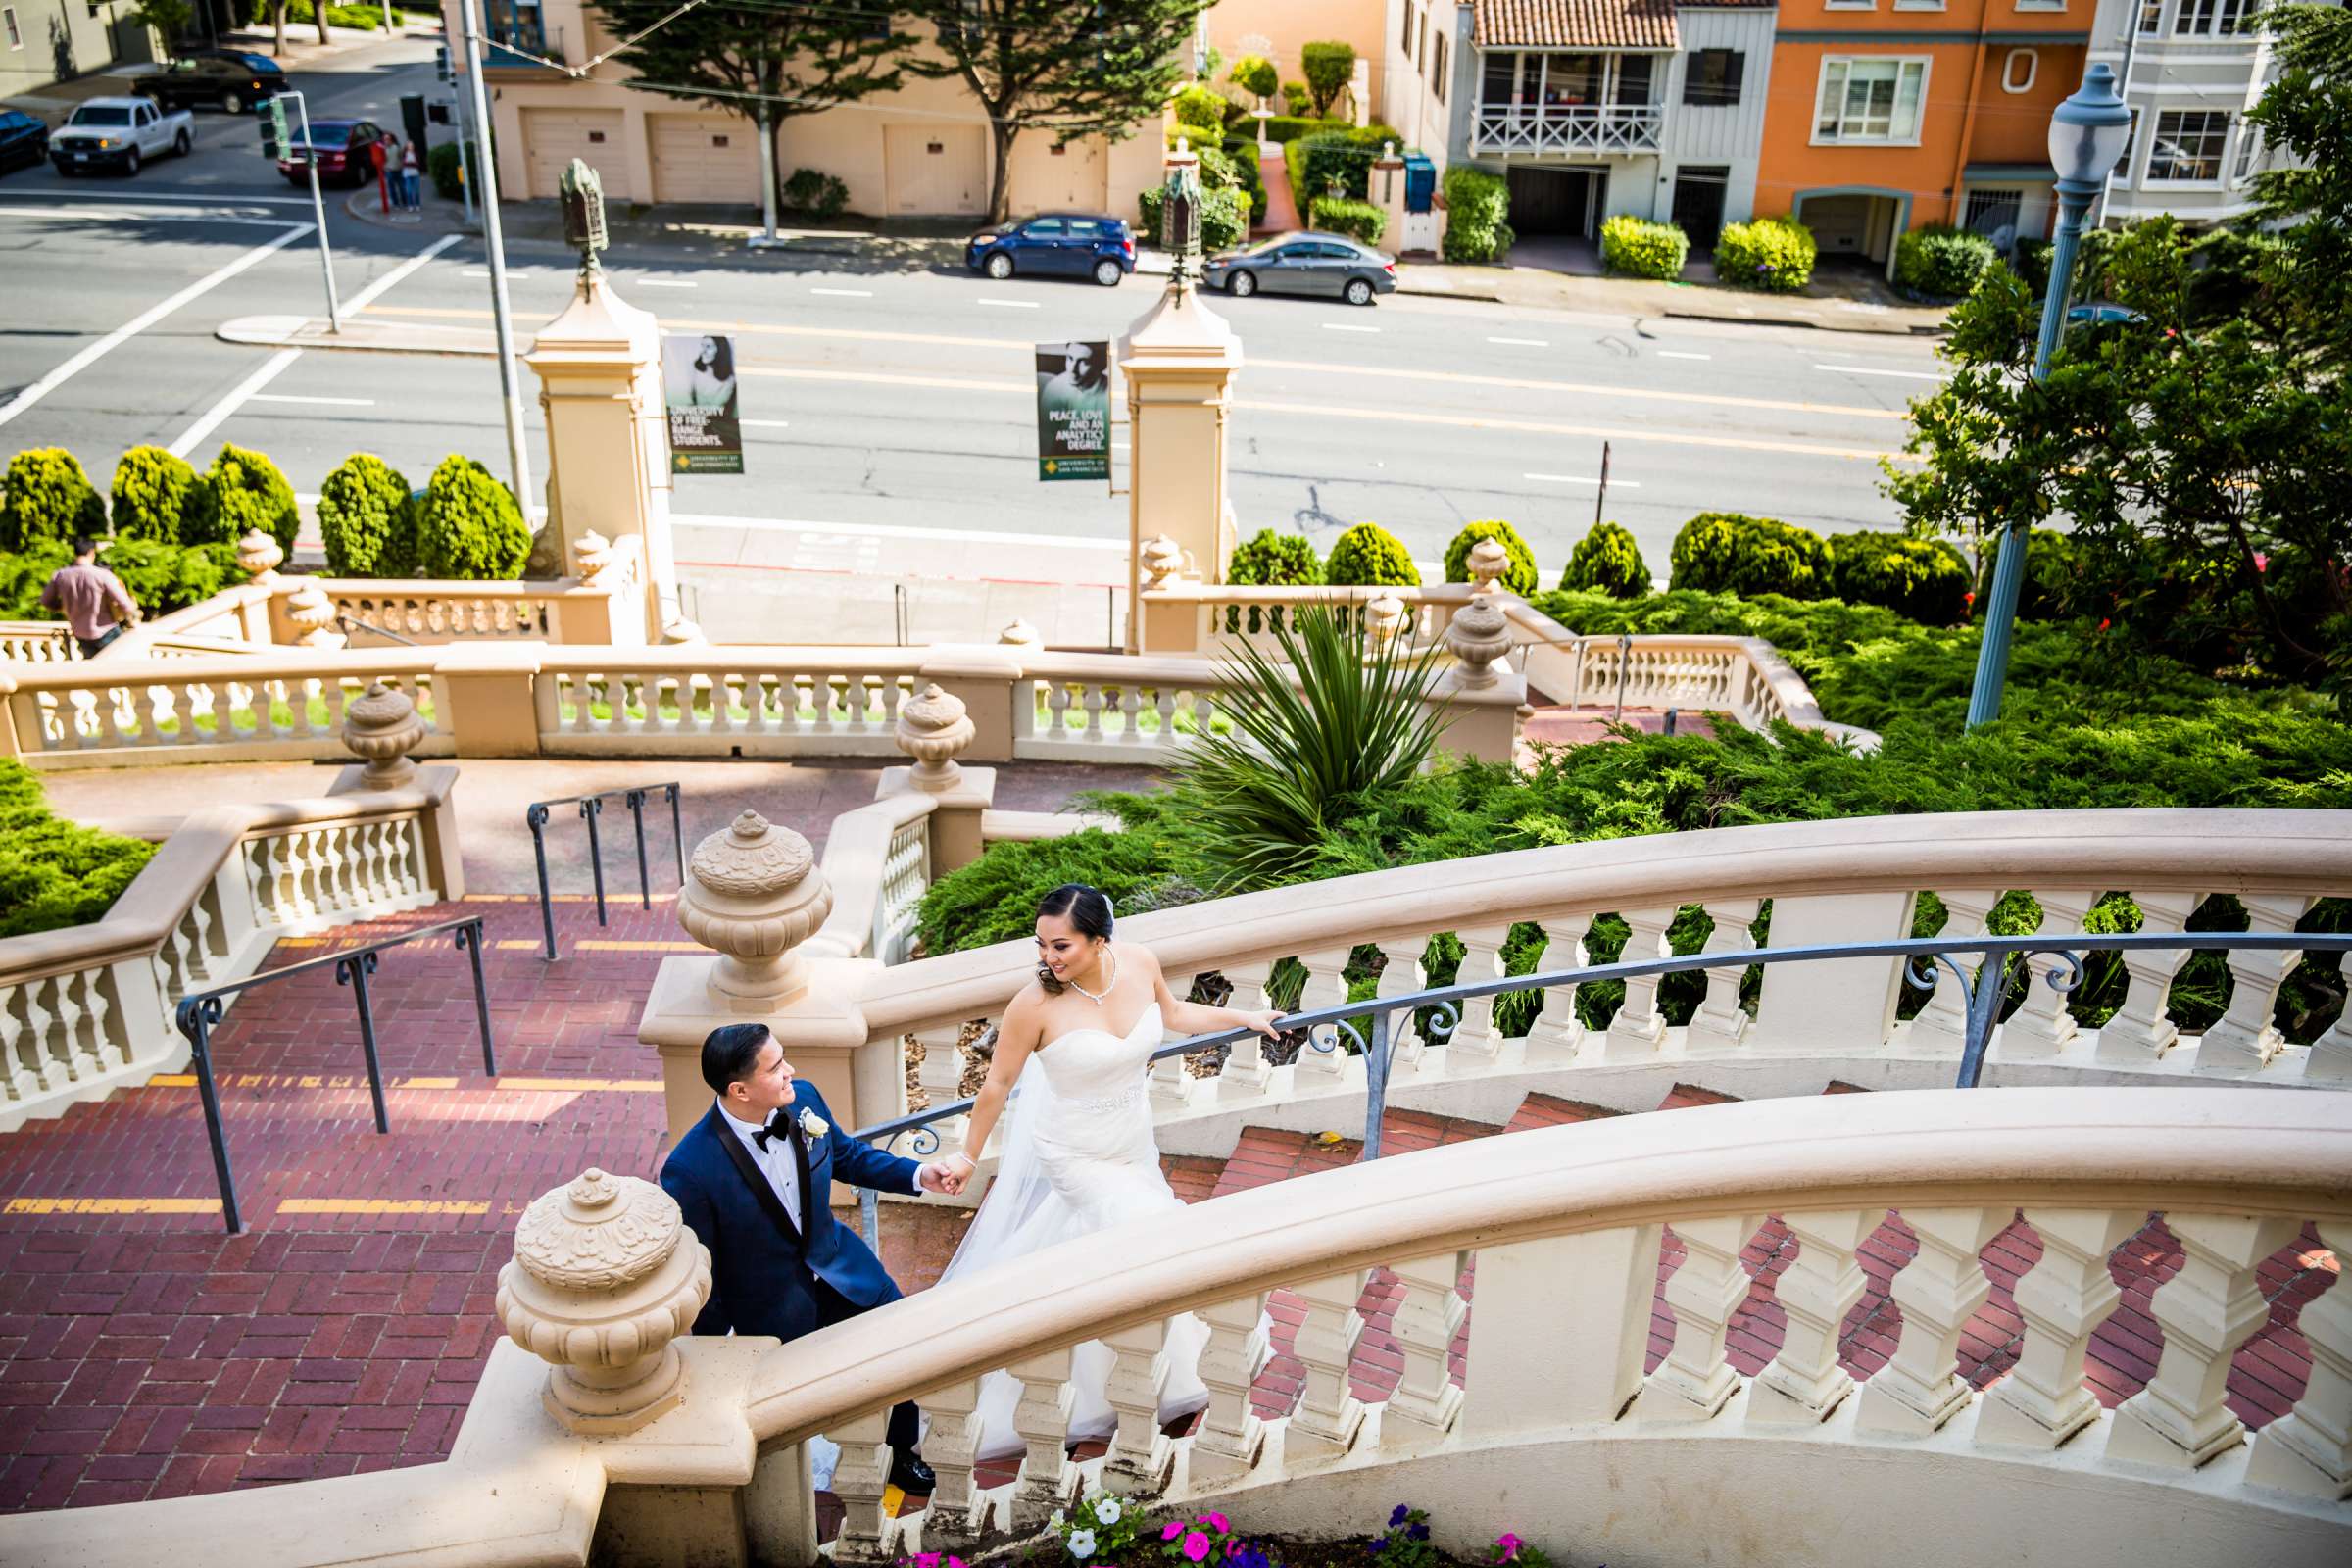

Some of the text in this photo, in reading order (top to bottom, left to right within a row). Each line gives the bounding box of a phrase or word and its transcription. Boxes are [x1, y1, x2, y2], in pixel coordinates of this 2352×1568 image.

[1081, 410, 1103, 419] LOVE
[1069, 419, 1105, 430] AND AN
[1055, 429, 1105, 441] ANALYTICS
